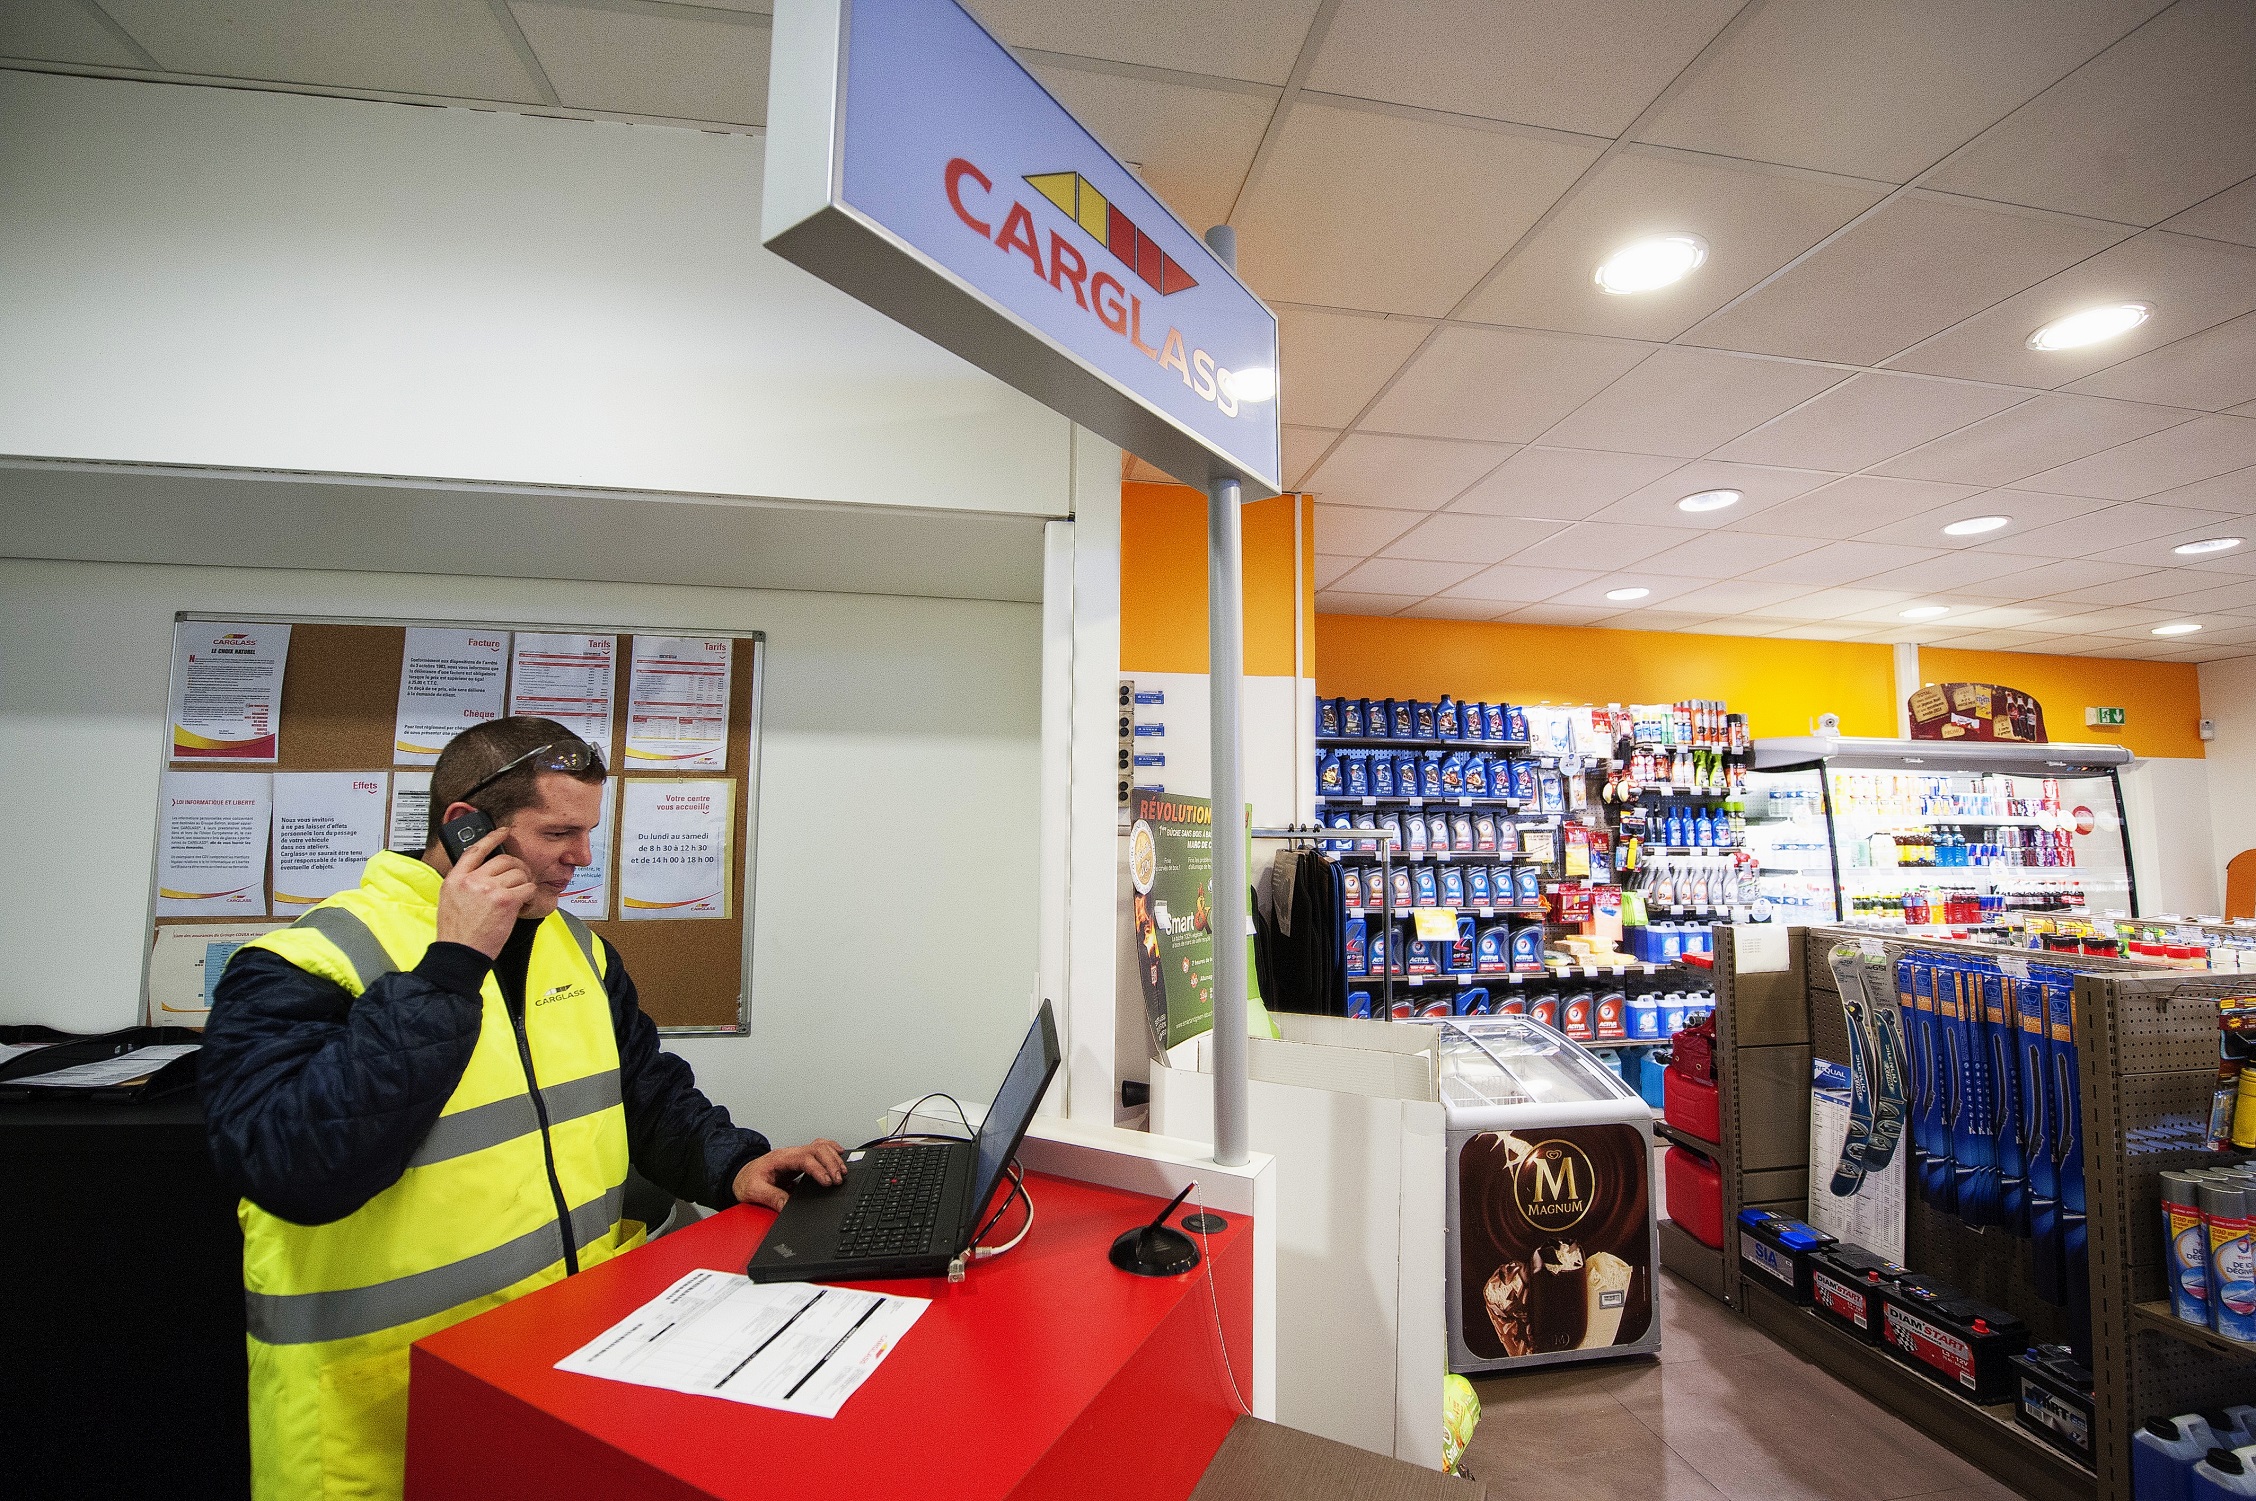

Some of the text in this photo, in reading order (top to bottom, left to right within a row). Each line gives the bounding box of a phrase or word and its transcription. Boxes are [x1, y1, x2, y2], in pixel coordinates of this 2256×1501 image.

[944, 158, 1239, 418] CARGLASS
[468, 638, 500, 647] Facture
[588, 640, 611, 648] Tarifs
[705, 643, 726, 651] Tarifs
[463, 709, 495, 719] Chèque
[353, 781, 378, 789] Effets
[1166, 912, 1194, 935] Smart
[535, 988, 585, 1007] CARGLASS
[1533, 1156, 1579, 1203] M
[1528, 1200, 1583, 1216] MAGNUM
[2173, 1215, 2187, 1223] 200
[2212, 1227, 2227, 1235] 200
[1890, 1309, 1964, 1351] DIAM'START
